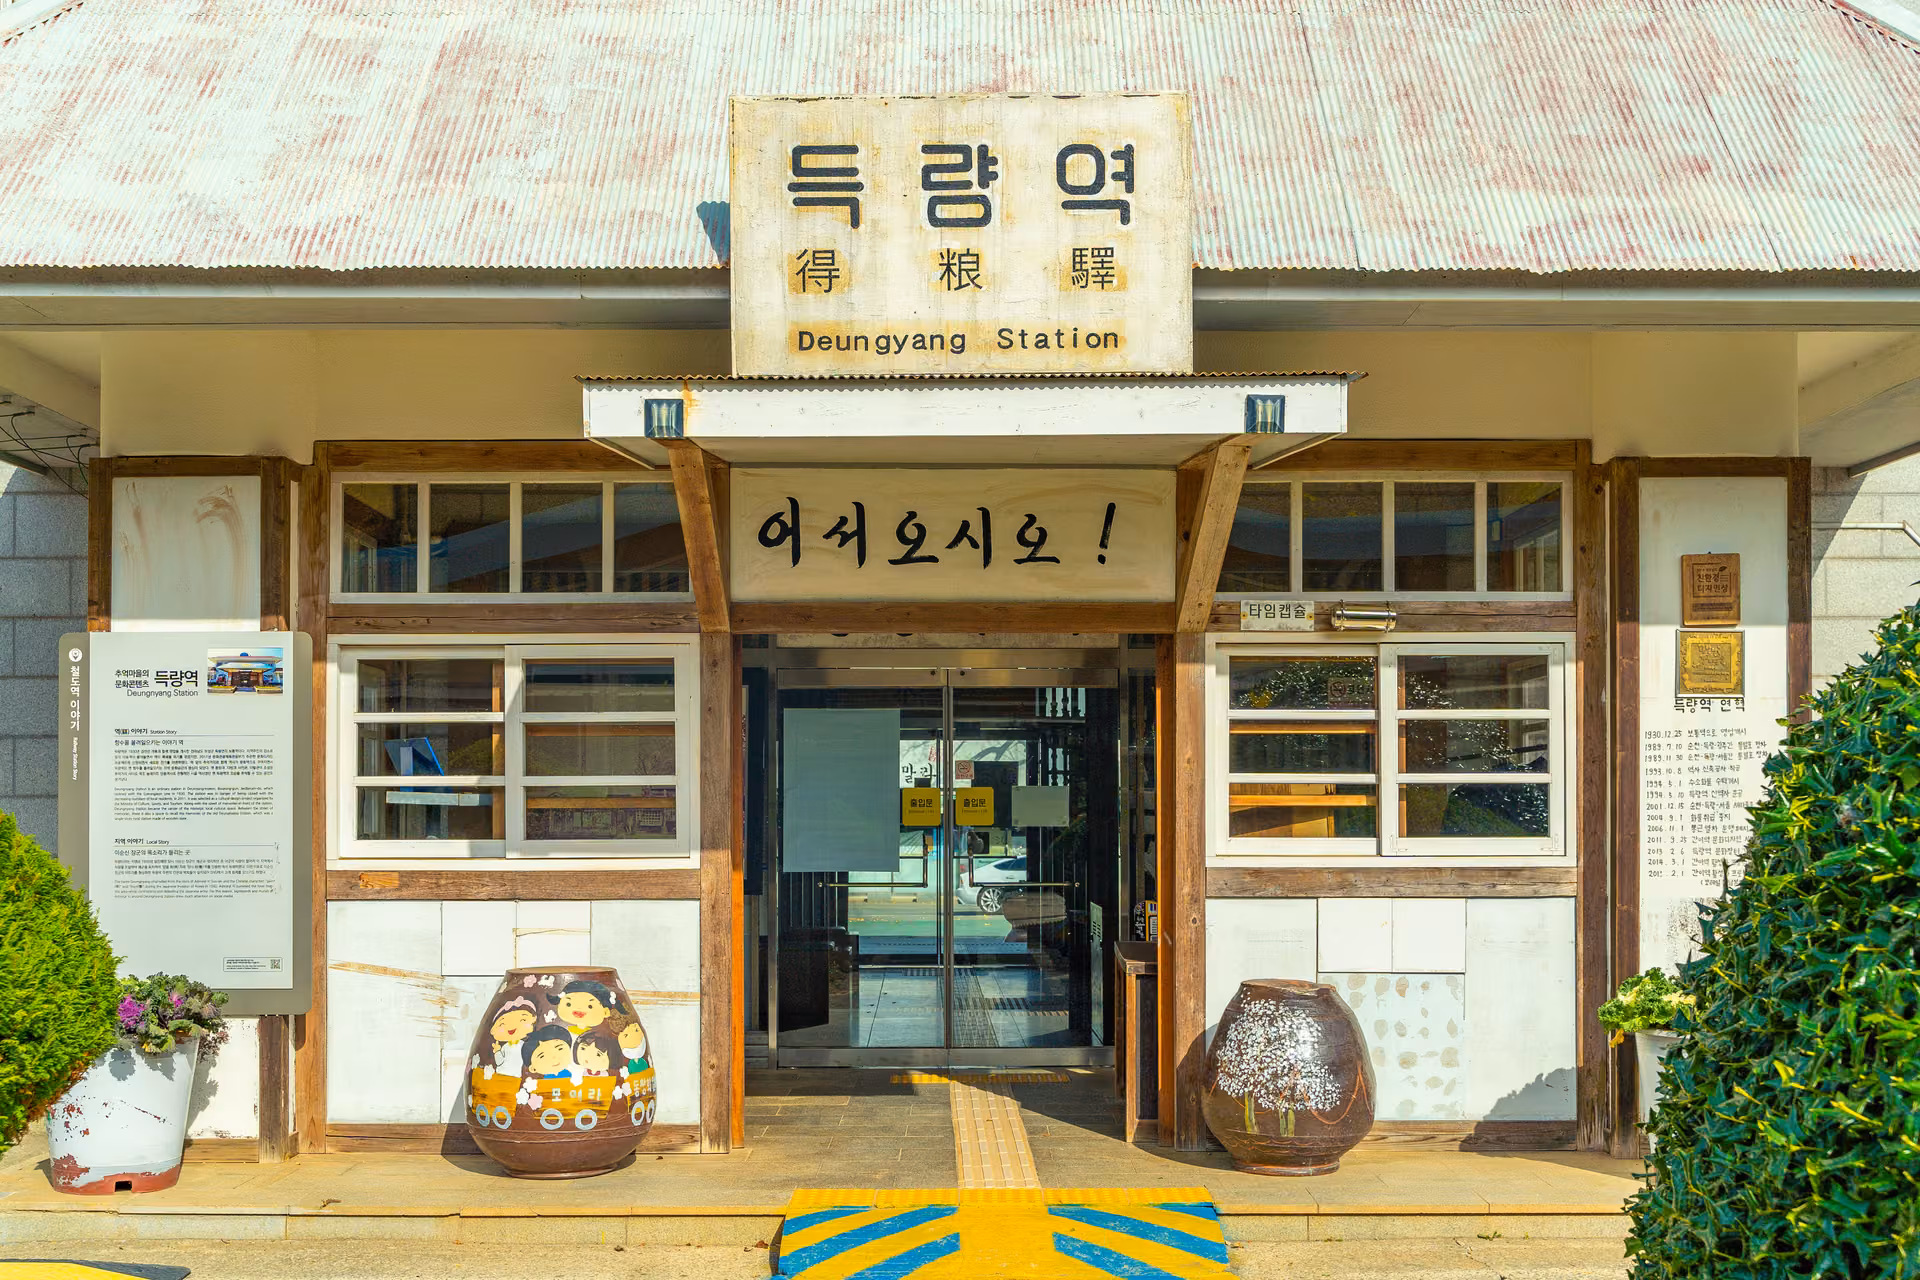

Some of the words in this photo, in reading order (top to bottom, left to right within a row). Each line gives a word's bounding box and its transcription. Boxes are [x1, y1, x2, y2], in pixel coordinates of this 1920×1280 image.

[799, 330, 967, 355] Deungyang
[997, 327, 1119, 350] Station
[1697, 572, 1720, 582] 친환경
[1249, 603, 1306, 619] 타임캡슐
[70, 665, 80, 697] 철도역
[114, 669, 150, 678] 추억마을의
[154, 670, 198, 688] 득량역
[126, 689, 172, 698] Deungnyang
[1674, 698, 1711, 714] 득량역
[70, 699, 80, 731] 이야기
[910, 799, 933, 808] 출입문
[963, 799, 986, 808] 출입문
